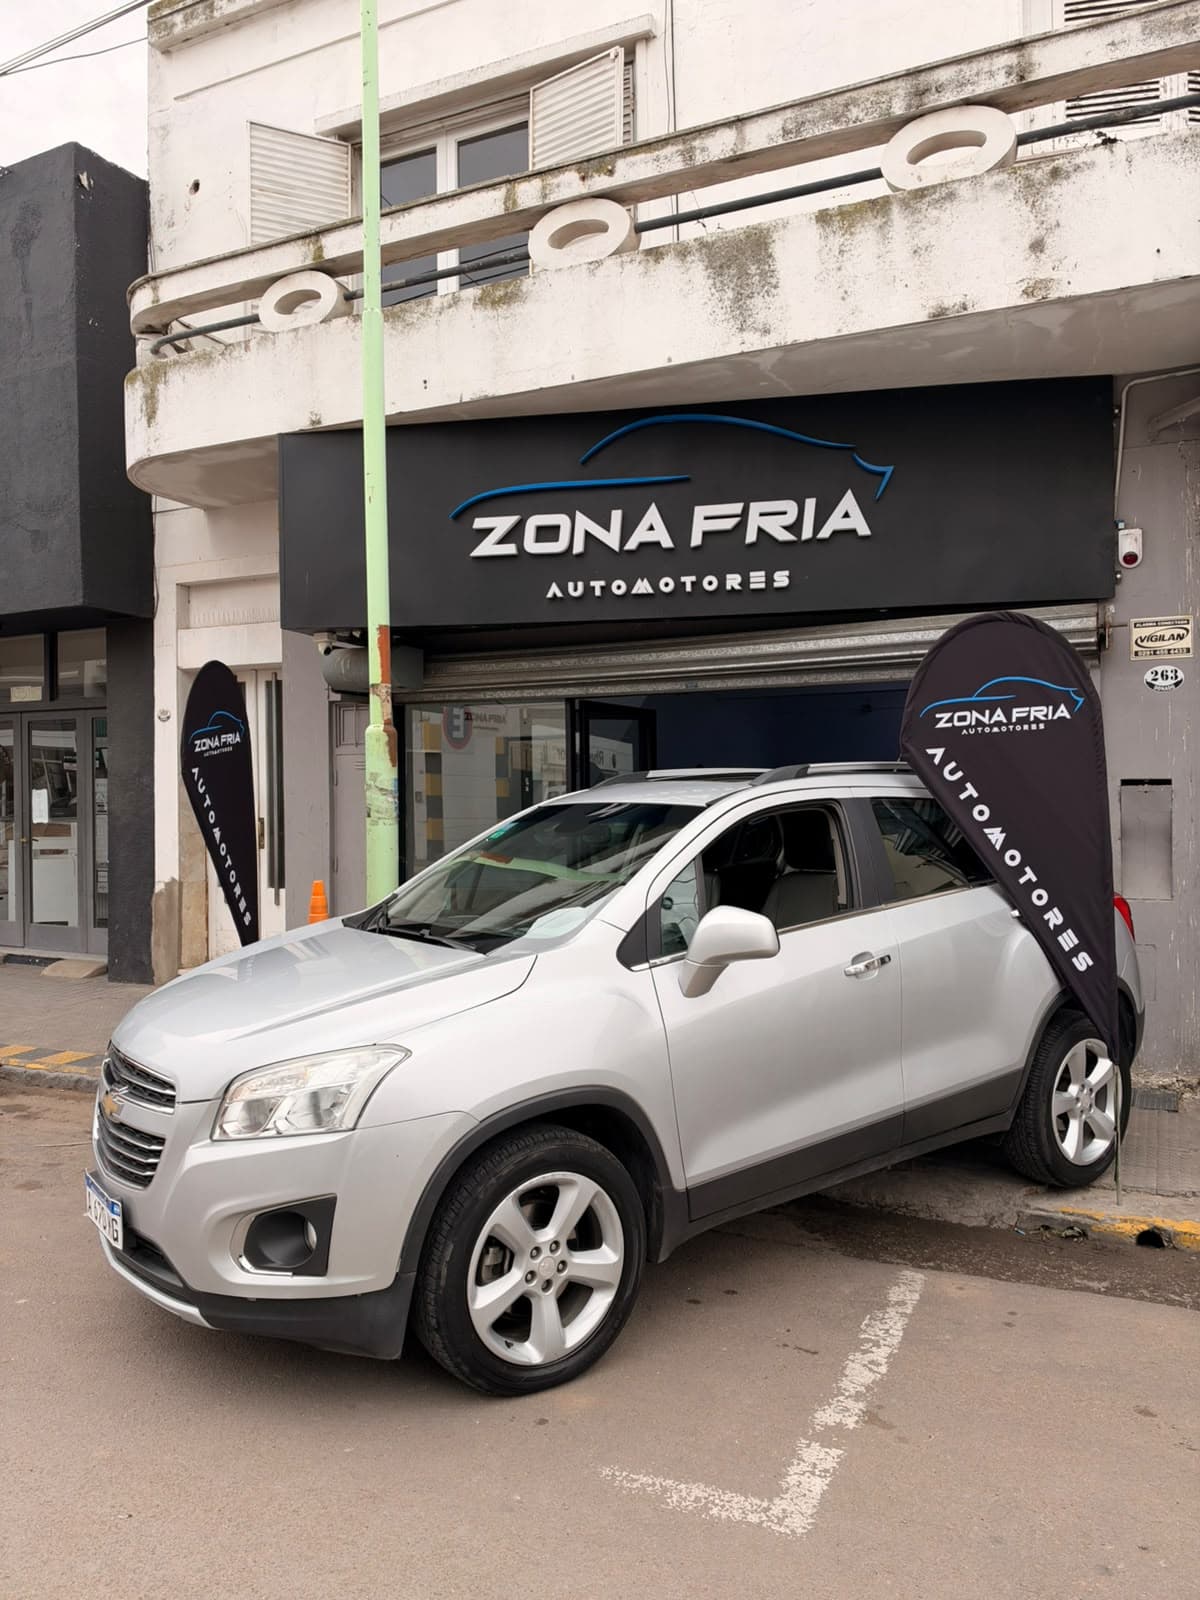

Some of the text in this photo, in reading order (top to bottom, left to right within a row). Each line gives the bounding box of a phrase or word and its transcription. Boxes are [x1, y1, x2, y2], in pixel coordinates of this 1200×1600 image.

[469, 488, 871, 557] ZONA FRIA
[546, 570, 790, 598] AUTOMOTORES
[1139, 632, 1185, 643] VIGILAN
[1150, 669, 1179, 682] 263
[934, 703, 1072, 728] ZONA FRIA
[194, 735, 220, 752] ZONA
[220, 731, 241, 747] FRIA
[961, 723, 1045, 735] AUTOMOTORES
[191, 767, 252, 926] AUTOMOTORES
[926, 747, 1094, 972] AUTOMOTORES
